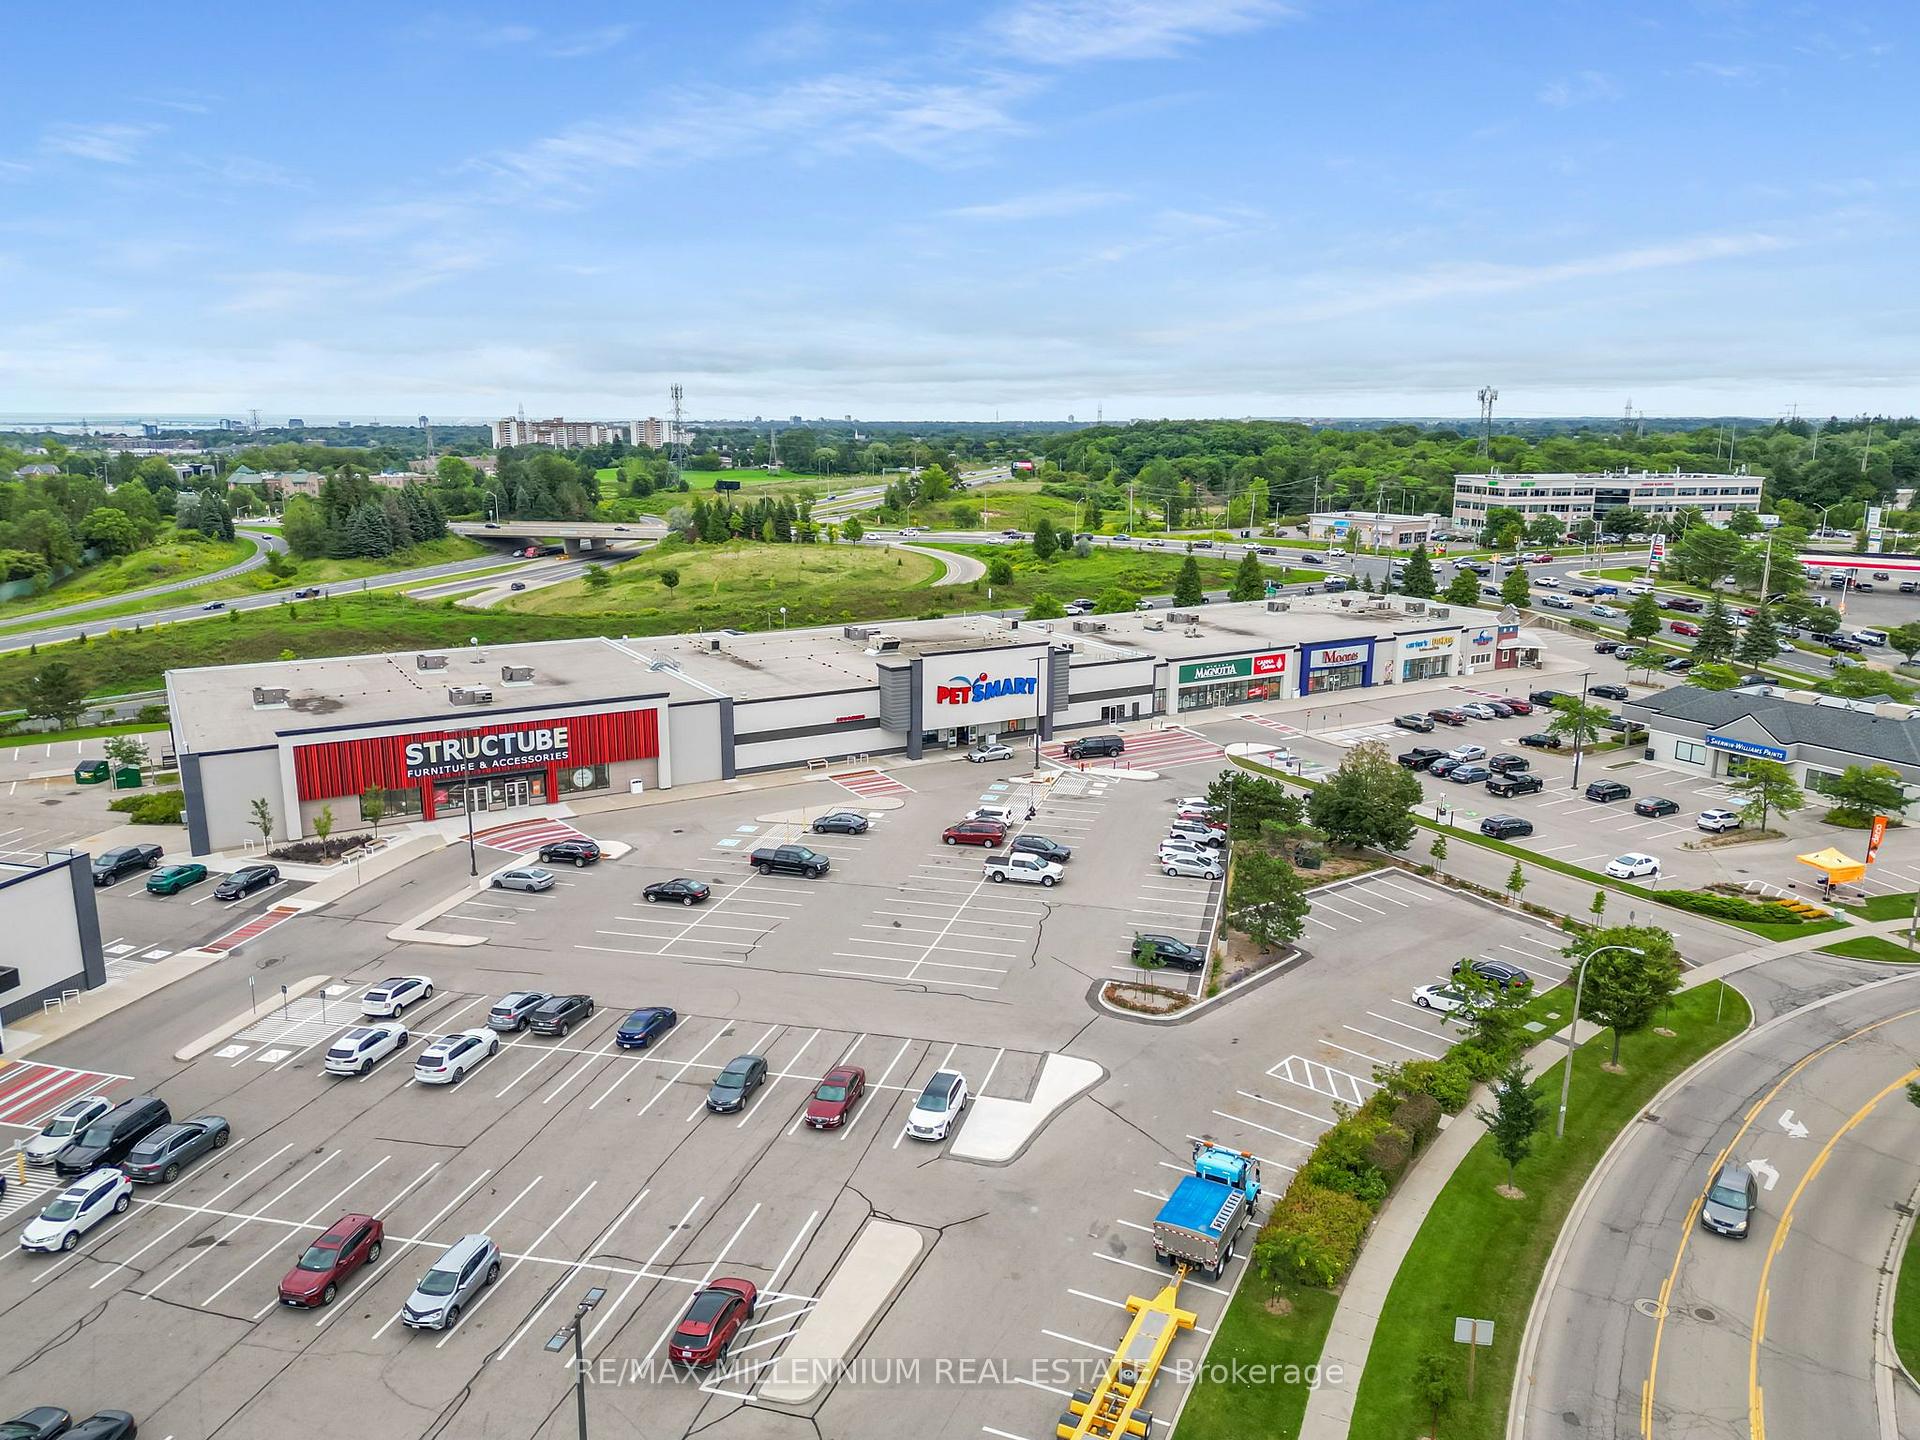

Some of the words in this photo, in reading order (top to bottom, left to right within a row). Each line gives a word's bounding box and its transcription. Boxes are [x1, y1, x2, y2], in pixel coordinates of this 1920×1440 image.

[1322, 650, 1358, 663] Moores
[936, 677, 1037, 704] PETSMART
[405, 727, 568, 766] STRUCTUBE
[407, 762, 475, 778] FURNITURE
[492, 751, 568, 768] ACCESSORIES
